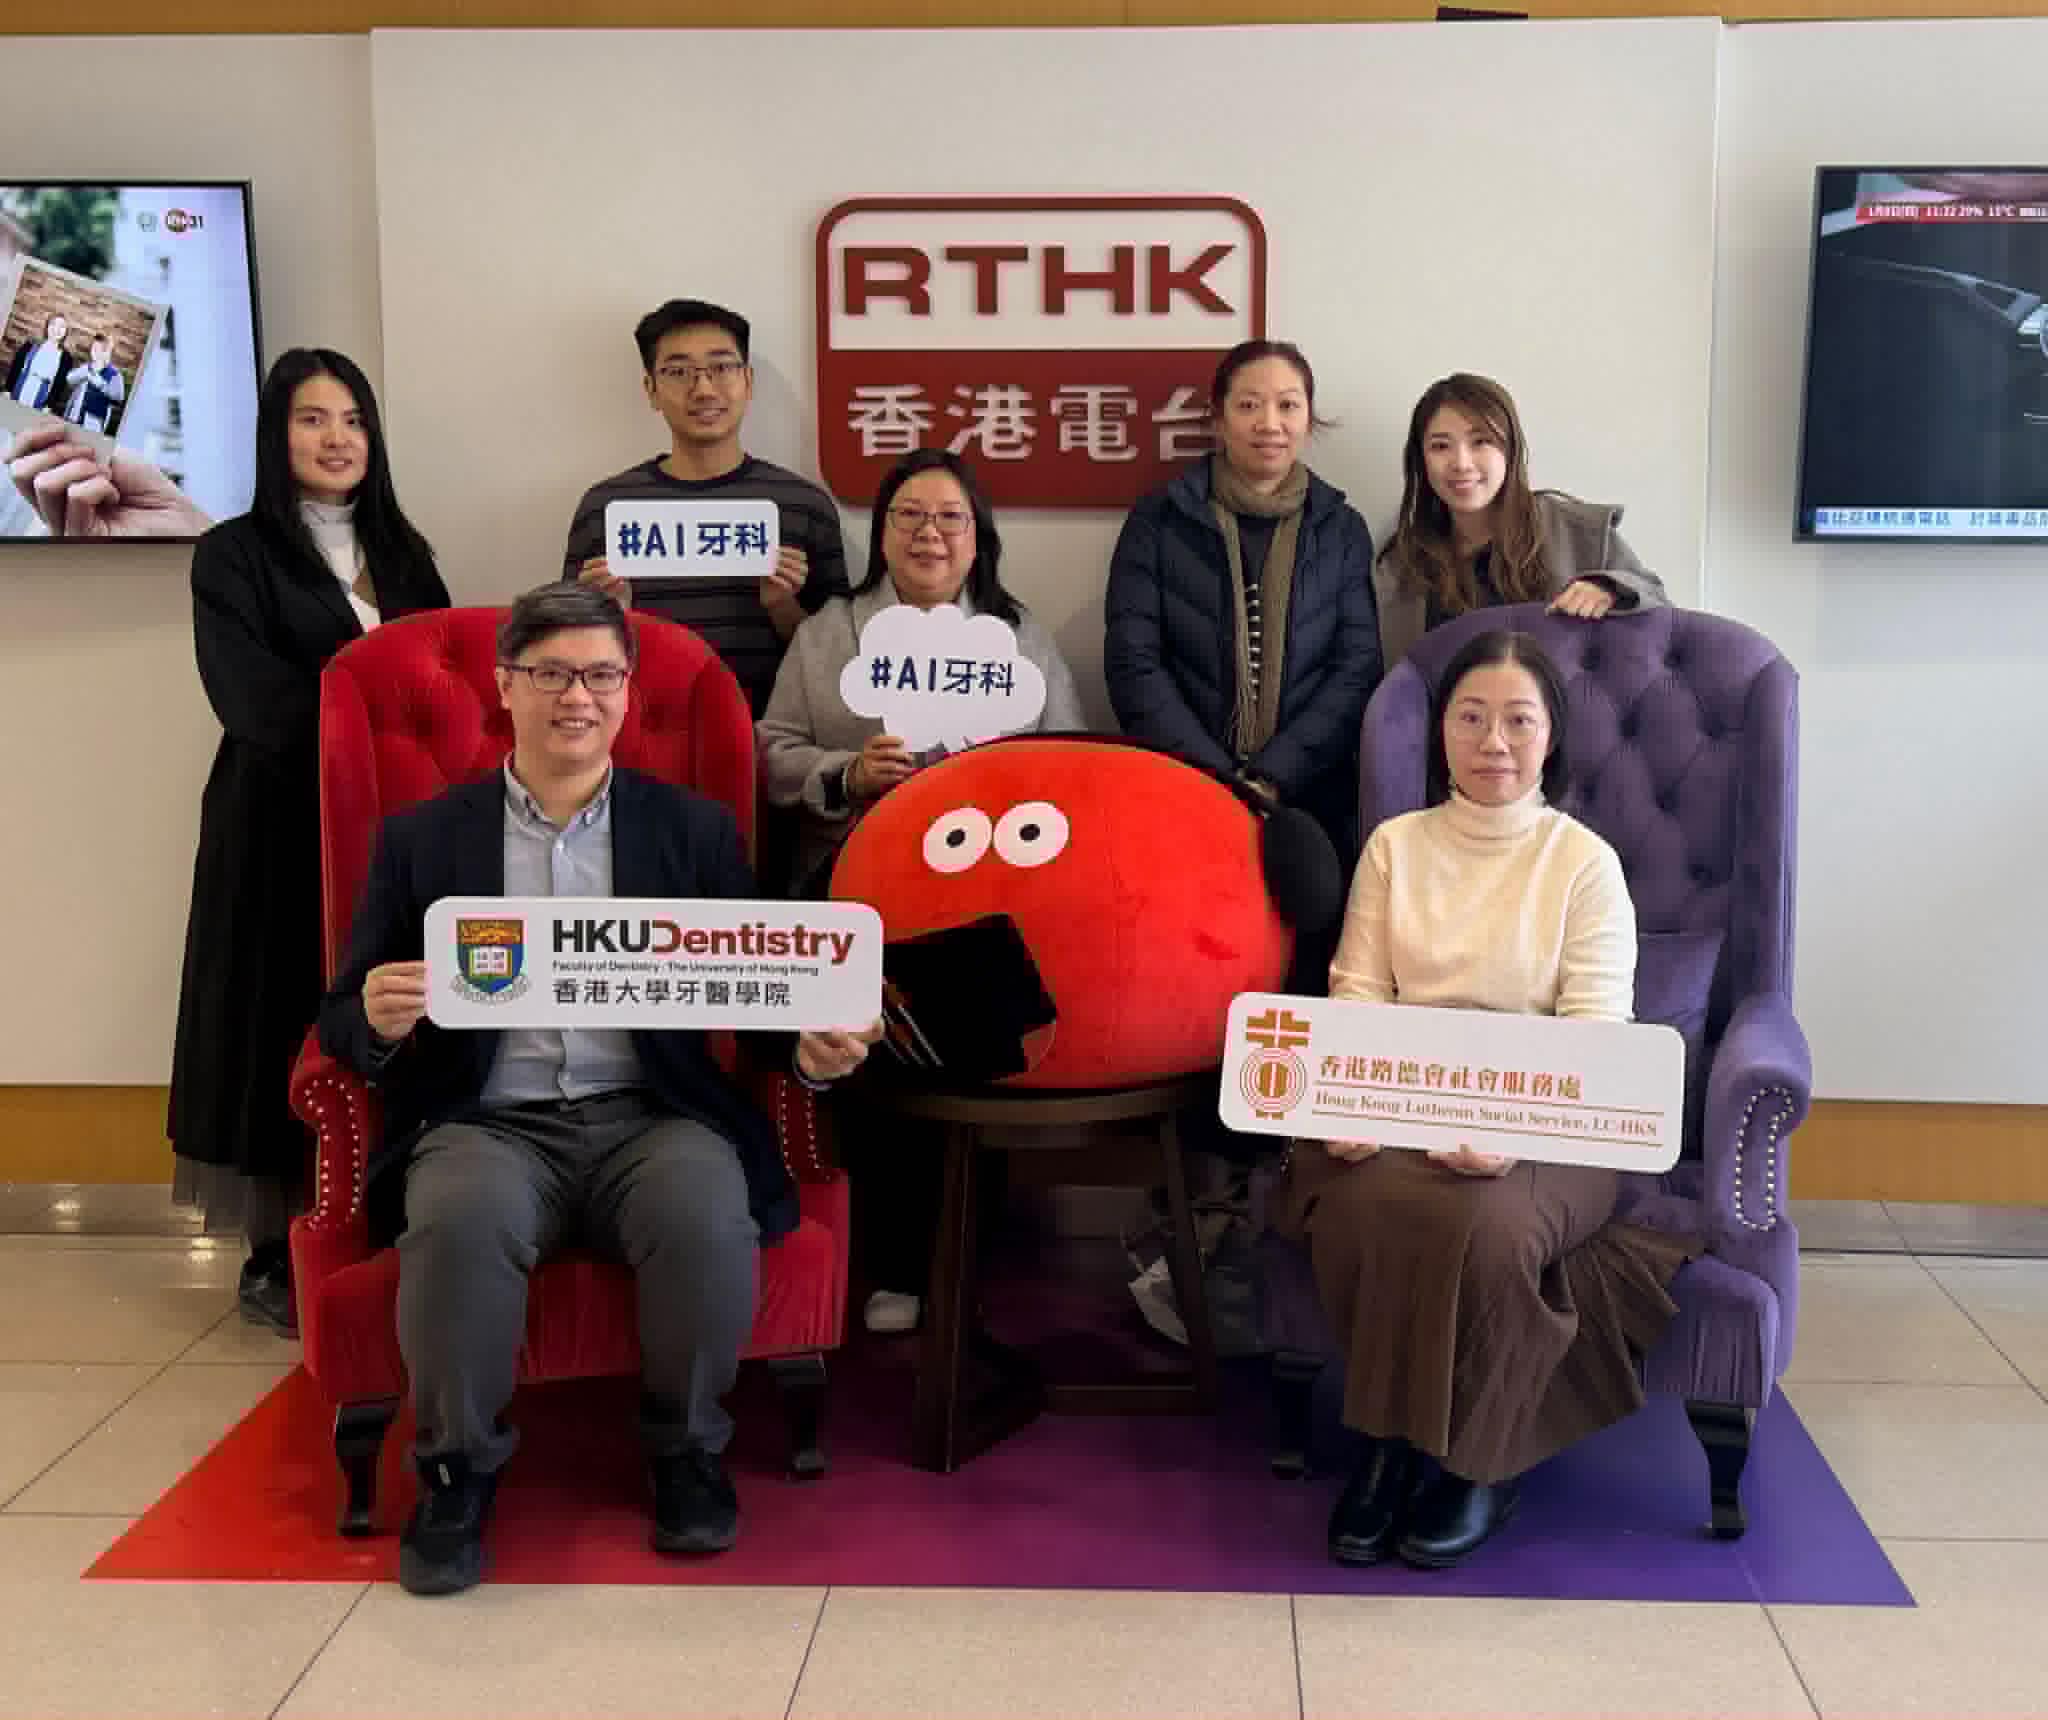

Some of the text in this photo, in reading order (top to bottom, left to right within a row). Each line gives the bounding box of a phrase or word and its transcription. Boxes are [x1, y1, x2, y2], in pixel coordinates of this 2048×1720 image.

[843, 245, 1236, 316] RTHK
[847, 384, 1214, 462] 香港電台
[552, 960, 593, 973] Faculty
[595, 960, 607, 971] of
[609, 960, 660, 973] Dentistry
[668, 961, 687, 972] The
[689, 961, 744, 975] University
[552, 978, 791, 1008] 香港大學牙醫學院
